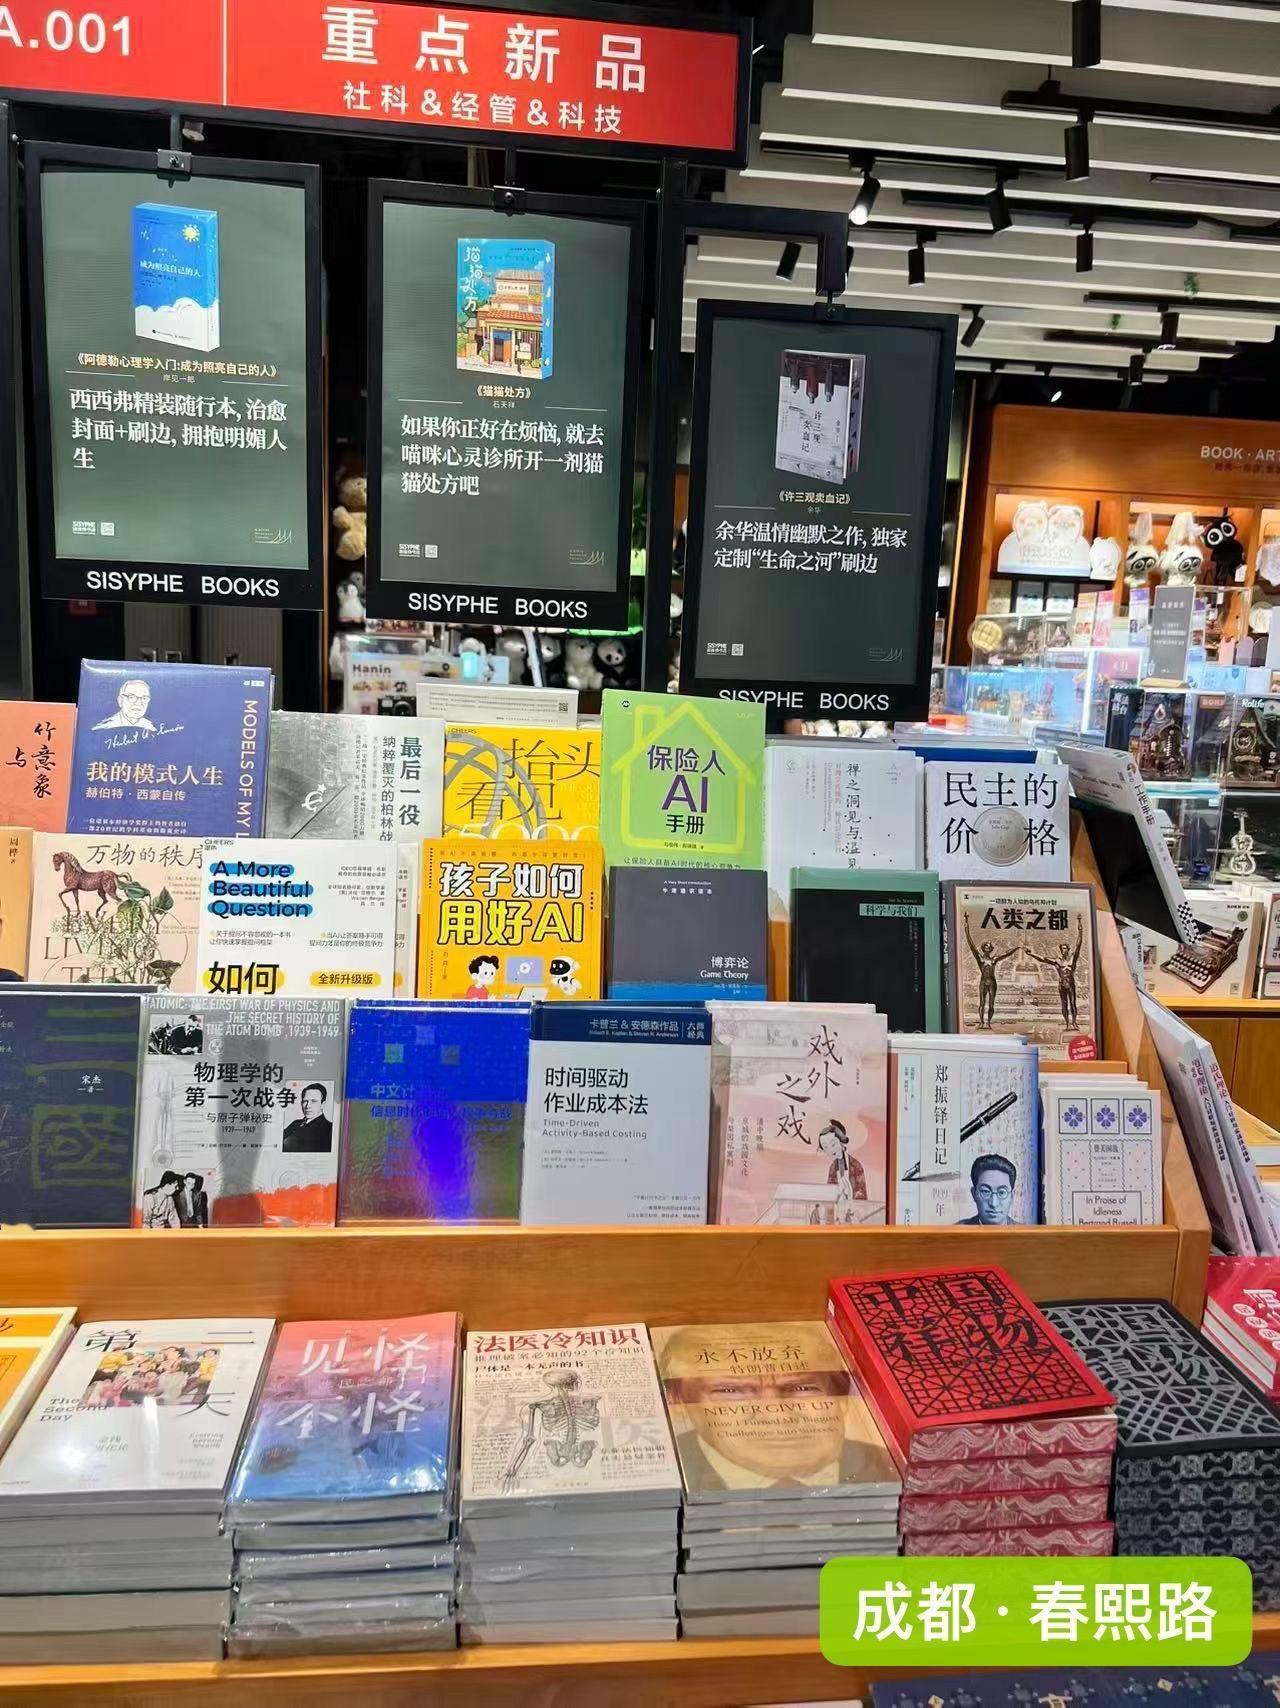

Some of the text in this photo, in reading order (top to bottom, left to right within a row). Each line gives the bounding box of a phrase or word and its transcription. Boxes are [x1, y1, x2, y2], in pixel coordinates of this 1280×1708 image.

[321, 5, 647, 93] 重点新品
[344, 79, 623, 135] 社科&经管&科技
[477, 385, 532, 399] 《猫猫处方》
[72, 446, 96, 470] 生
[400, 444, 605, 475] 喵咪心灵诊所开一剂猫
[1200, 445, 1243, 460] BOOK
[400, 471, 480, 497] 猫处方吧
[86, 571, 280, 598] SISYPHE BOOKS
[407, 592, 588, 619] SISYPHE BOOKS
[353, 664, 392, 674] Hanin
[718, 689, 890, 711] SISYPHE BOOKS
[236, 699, 259, 828] MODELS OF MY
[502, 738, 601, 781] 抬头
[647, 744, 726, 776] 保险人
[86, 761, 224, 786] 我的模式人生
[398, 736, 422, 827] 最后一役
[455, 781, 563, 821] 看见
[661, 774, 710, 814] AI
[943, 771, 1059, 808] 民主的
[665, 814, 705, 835] 手册
[213, 861, 292, 878] A More
[439, 861, 585, 899] 孩子如何
[212, 879, 310, 898] Beautiful
[211, 899, 310, 919] Question
[980, 907, 1069, 931] 人类之都
[437, 898, 585, 945] 用好AI
[711, 955, 750, 969] 博弈论
[208, 961, 280, 995] 如何
[318, 973, 373, 985] 全新升级版
[700, 968, 750, 980] Game Theory
[210, 1000, 340, 1012] FIRST WAR OF PHYSICS AND
[206, 1024, 223, 1036] THE
[225, 1024, 250, 1036] ATOM
[248, 1012, 284, 1024] SECRET
[286, 1012, 325, 1025] HISTORY
[327, 1013, 340, 1025] OF
[620, 1020, 629, 1030] &
[193, 1061, 284, 1084] 物理学的
[545, 1066, 629, 1089] 时间驱动
[184, 1086, 298, 1108] 第一次战争
[544, 1092, 649, 1115] 作业成本法
[206, 1112, 273, 1124] 与原子弹秘史
[543, 1118, 600, 1128] Time-Driven
[934, 1064, 949, 1166] 郑振铎日记
[542, 1129, 647, 1140] Activity-Based Costing
[1086, 1195, 1127, 1205] In Praise of
[1093, 1206, 1123, 1216] Idleness
[474, 1326, 642, 1354] 法医冷知识
[298, 1326, 430, 1390] 见怪
[697, 1344, 808, 1365] 永不放弃
[40, 1413, 73, 1423] Day
[704, 1400, 834, 1417] NEVER GIVE UP
